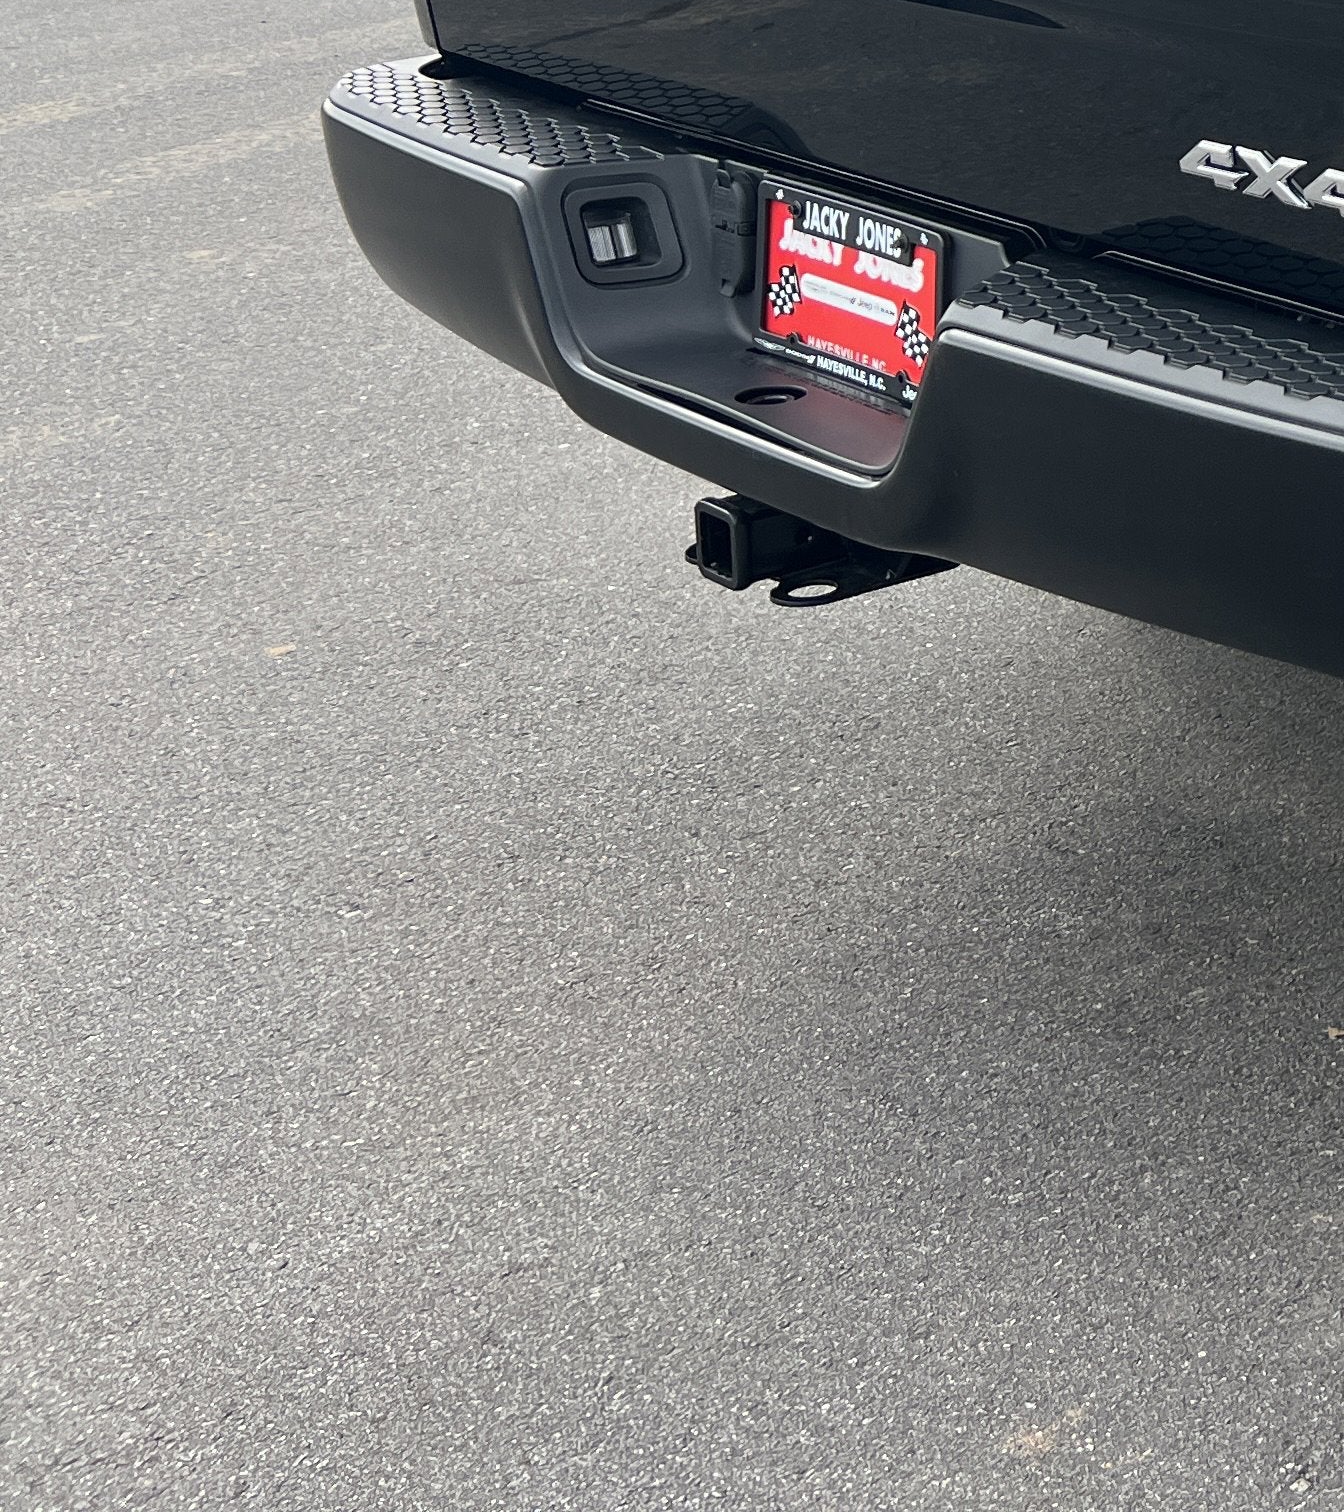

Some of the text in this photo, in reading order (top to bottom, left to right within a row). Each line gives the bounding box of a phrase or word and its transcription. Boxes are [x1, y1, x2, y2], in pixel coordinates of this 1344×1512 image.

[802, 200, 902, 259] JACKY JONES
[902, 384, 918, 401] Je
